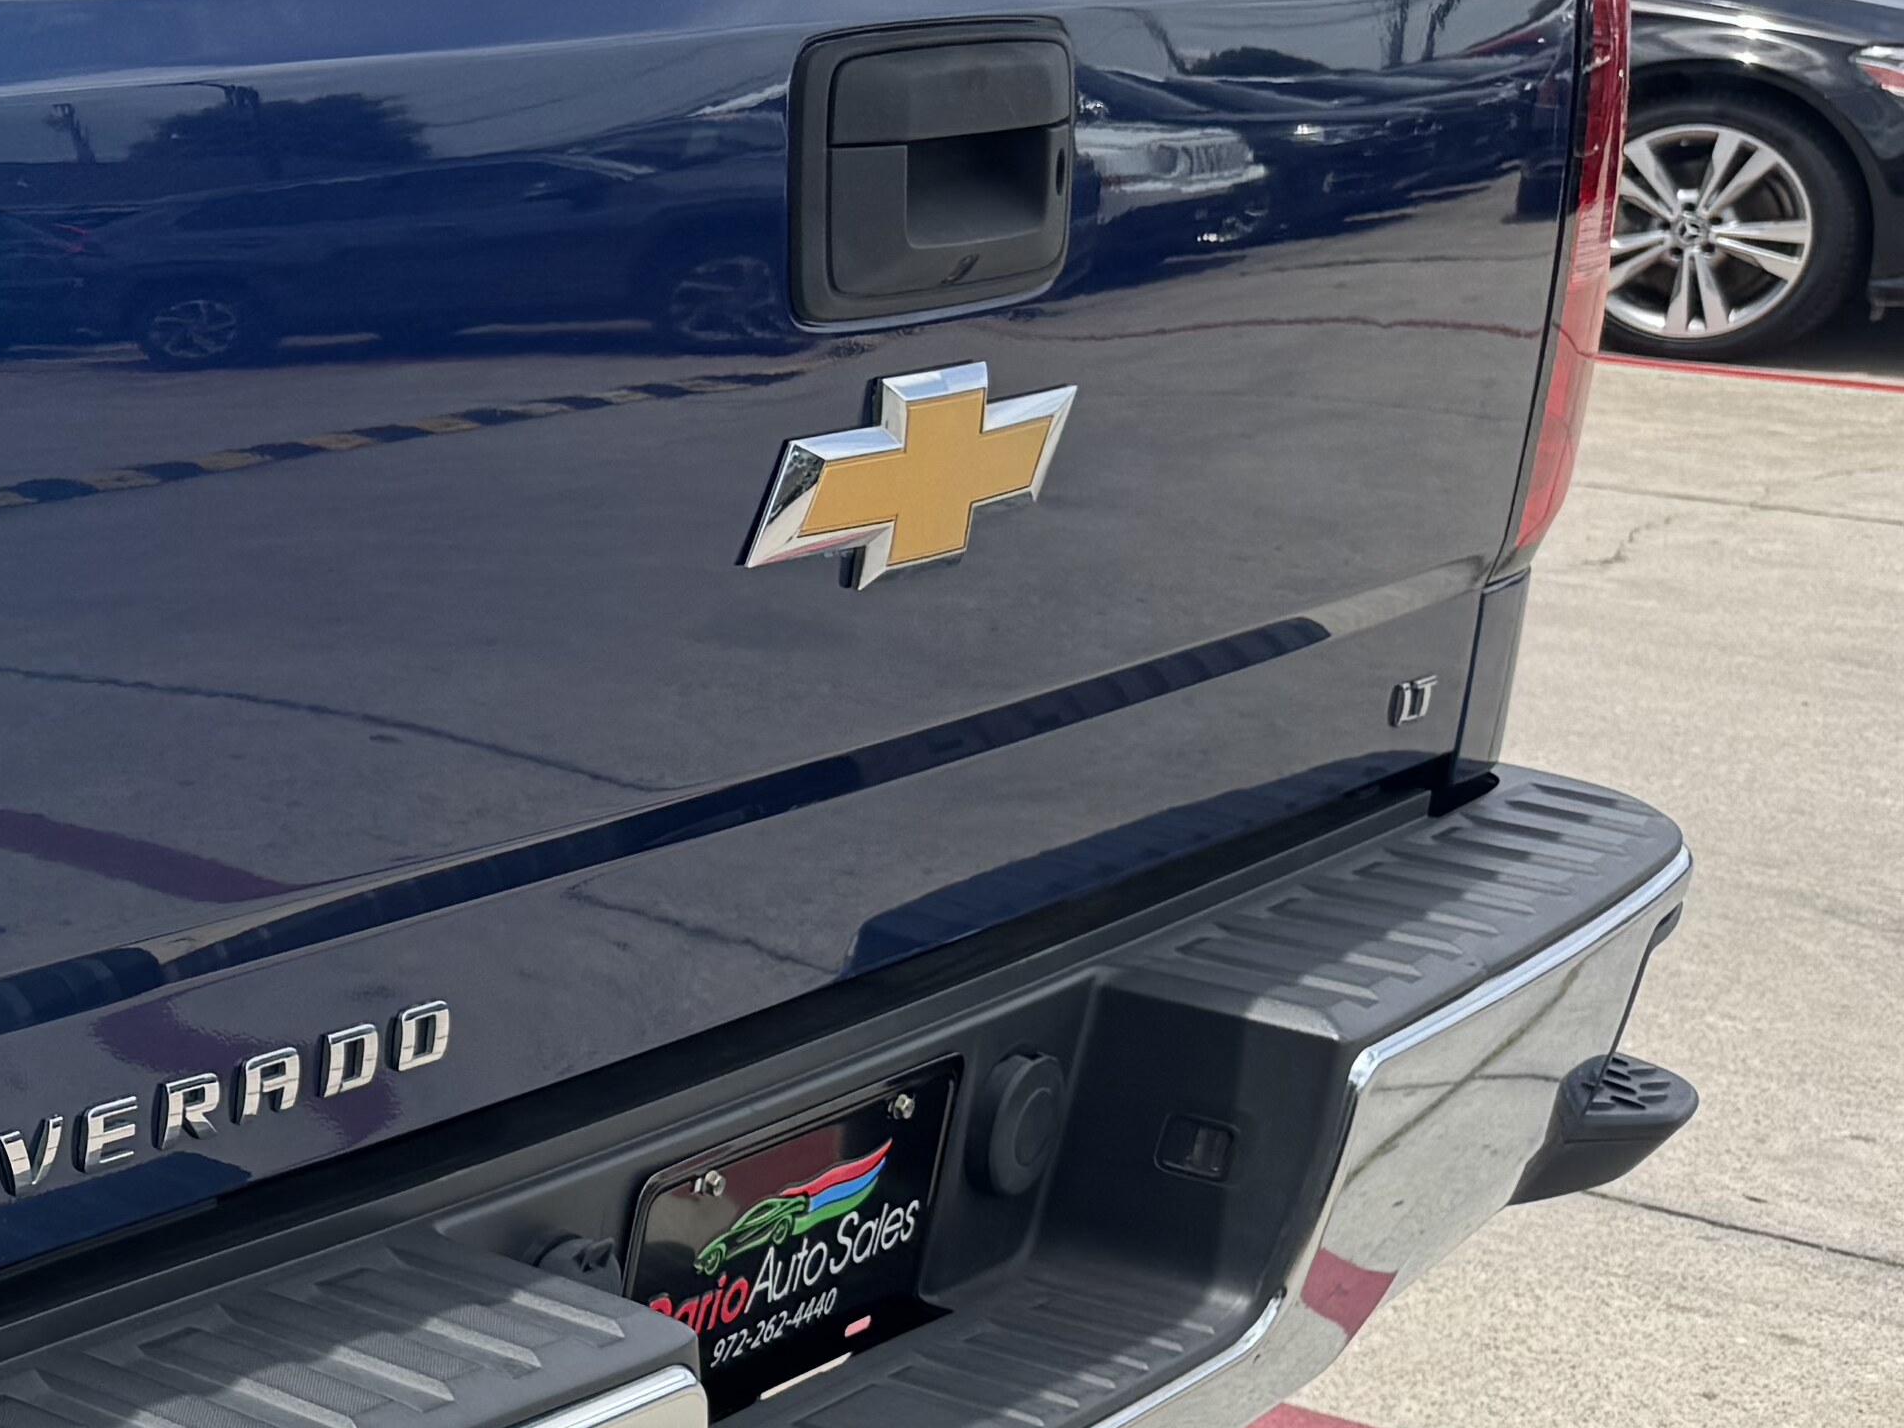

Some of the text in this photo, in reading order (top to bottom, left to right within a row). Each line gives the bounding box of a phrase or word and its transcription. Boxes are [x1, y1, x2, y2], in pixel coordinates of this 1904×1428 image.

[1390, 674, 1439, 727] LT
[743, 1237, 827, 1315] Auto
[828, 1199, 920, 1276] Sales
[709, 1287, 839, 1369] 972-262-4440
